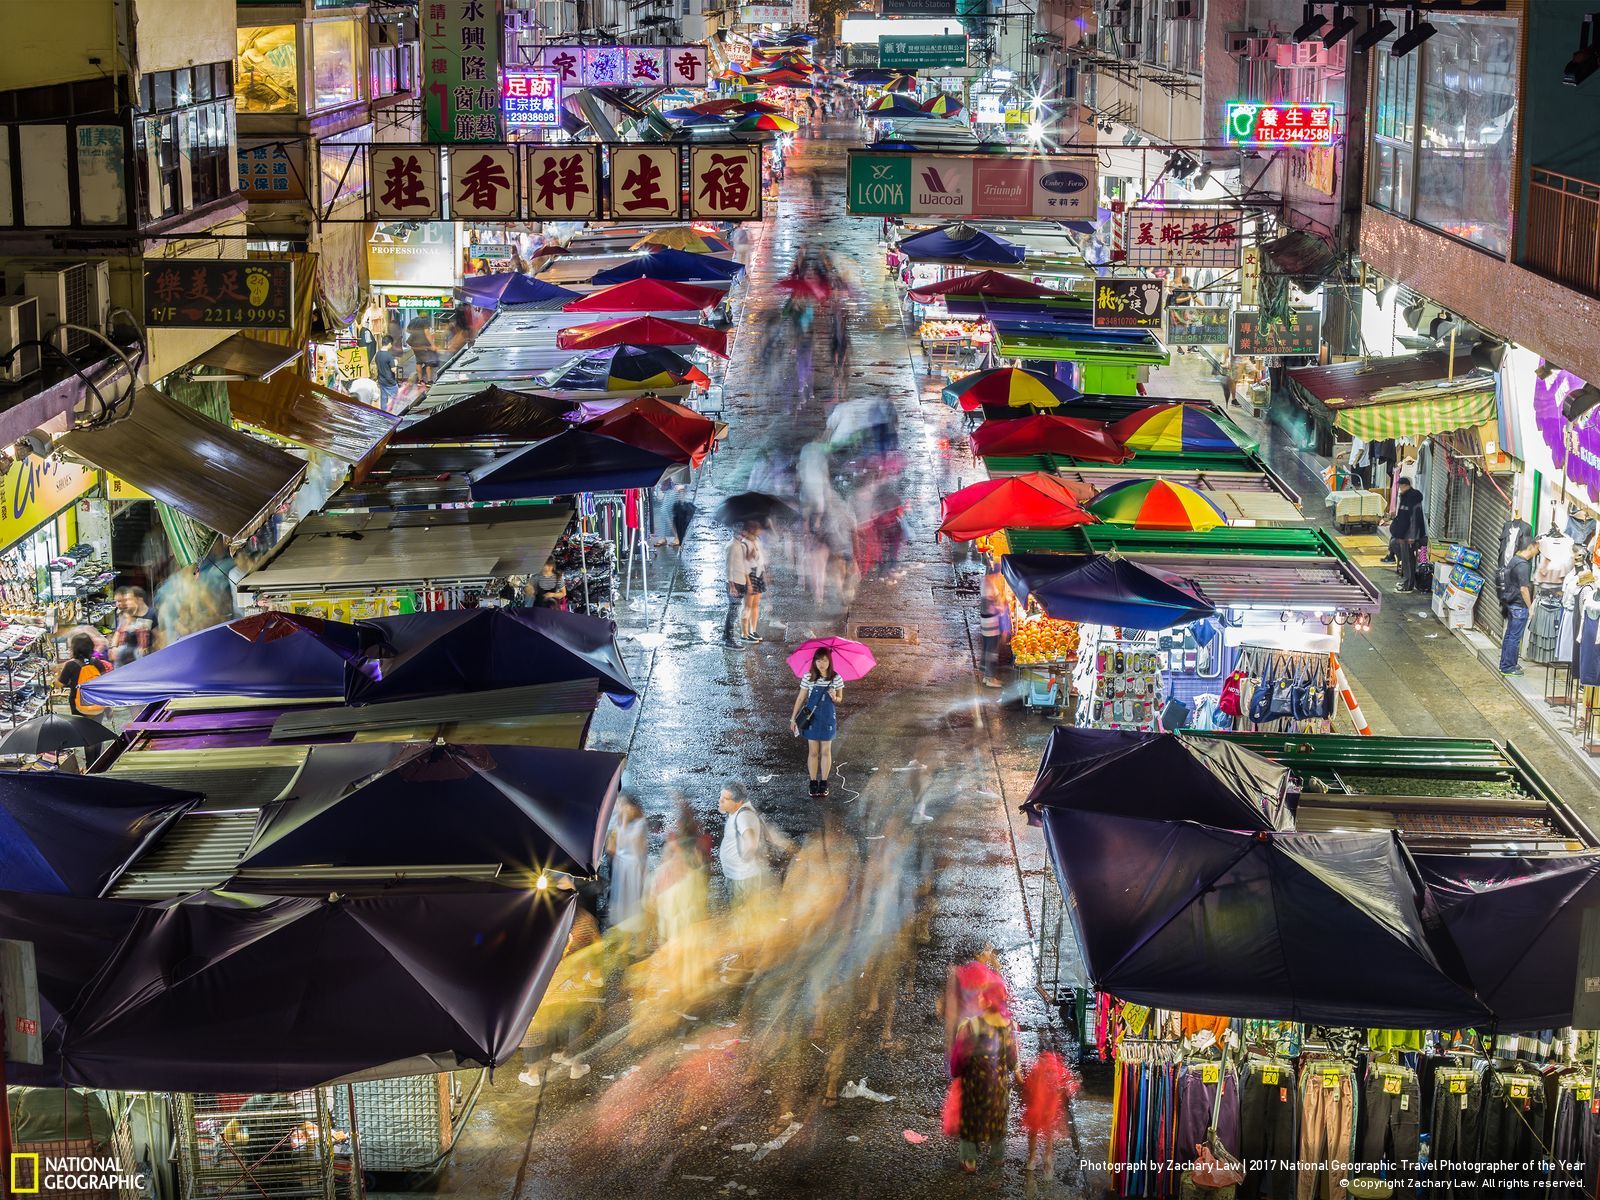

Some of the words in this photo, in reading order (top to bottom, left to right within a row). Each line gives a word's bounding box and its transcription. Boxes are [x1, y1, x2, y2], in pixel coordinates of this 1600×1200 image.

[430, 4, 447, 73] 請上一樓
[460, 0, 486, 80] 永興隆
[508, 79, 553, 97] 足跡
[505, 98, 555, 111] 正宗按摩
[1261, 109, 1328, 127] 養生堂
[1258, 128, 1329, 140] TEL:23442588
[858, 183, 904, 205] LEONA
[984, 184, 1022, 197] Triumph
[920, 194, 963, 206] Wacoal
[1048, 198, 1080, 207] 安莉芳
[371, 246, 441, 255] PROFESSIONAL
[154, 266, 250, 304] 樂美足
[250, 275, 264, 286] 24
[151, 307, 177, 321] 1/F
[205, 308, 242, 322] 2214
[247, 308, 286, 322] 9995
[1105, 317, 1137, 326] 34810700
[1148, 318, 1160, 326] 1/F
